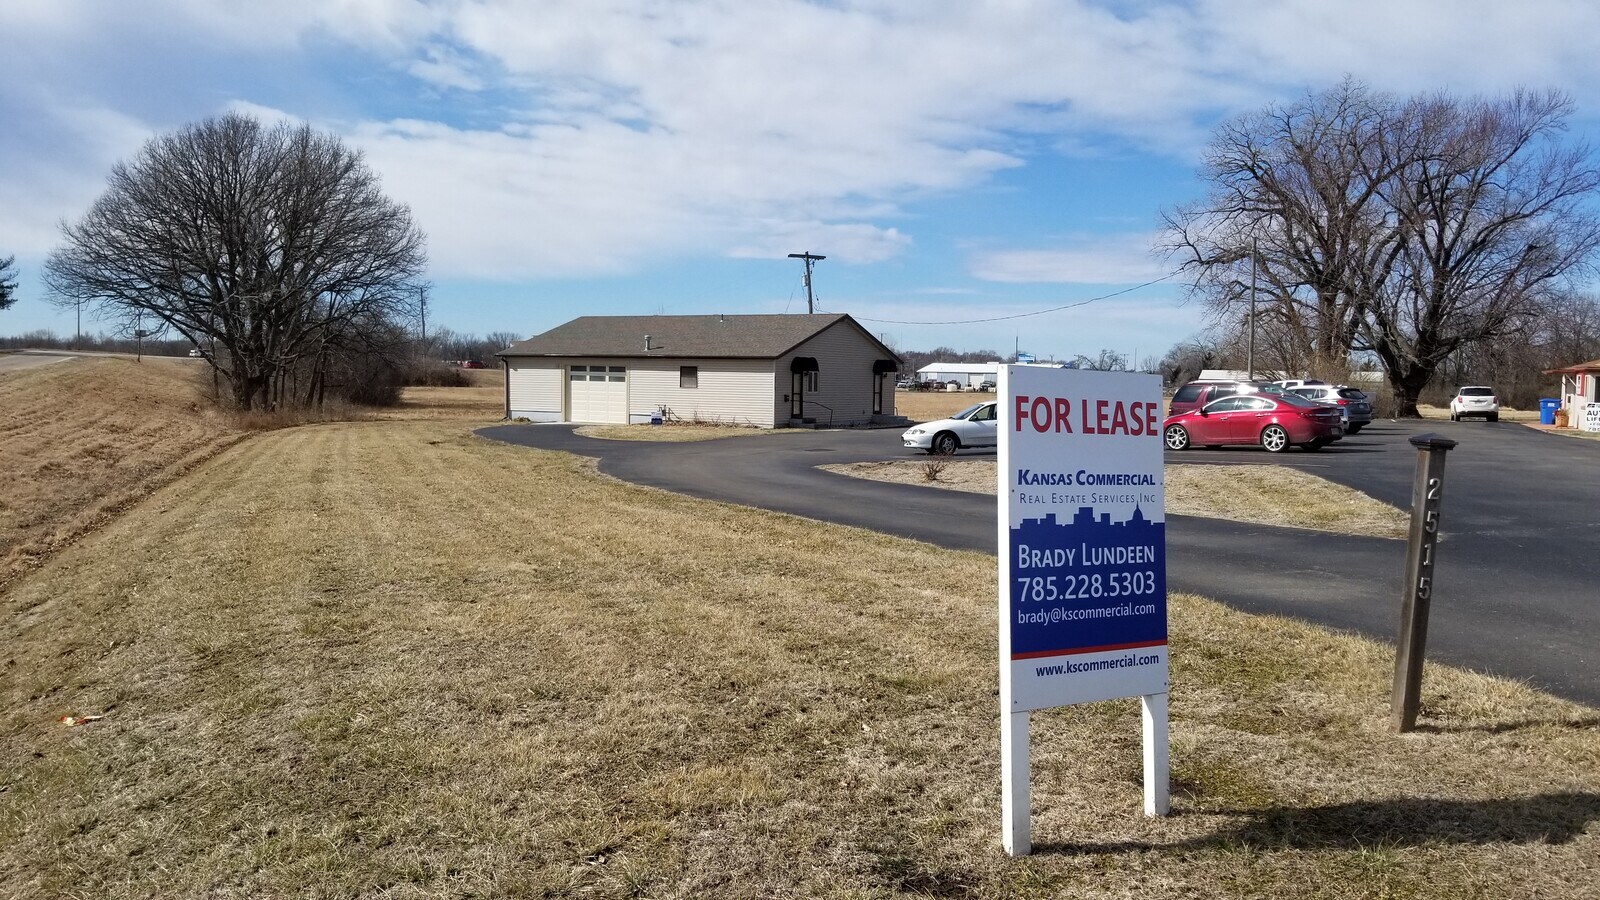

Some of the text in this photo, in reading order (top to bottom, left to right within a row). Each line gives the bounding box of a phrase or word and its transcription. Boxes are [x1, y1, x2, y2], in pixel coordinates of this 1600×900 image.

[1015, 395, 1158, 437] FOR LEASE
[1018, 469, 1156, 486] KANSAS COMMERCIAL
[1019, 492, 1156, 504] REAL ESTATE SERVICES INC
[1418, 477, 1441, 600] 2515
[1018, 542, 1155, 569] BRADY LUNDEEN
[1017, 570, 1156, 602] 785.228.5303
[1018, 602, 1156, 626] brady@kscommercial.com
[1035, 653, 1160, 677] www.kscommercial.com
